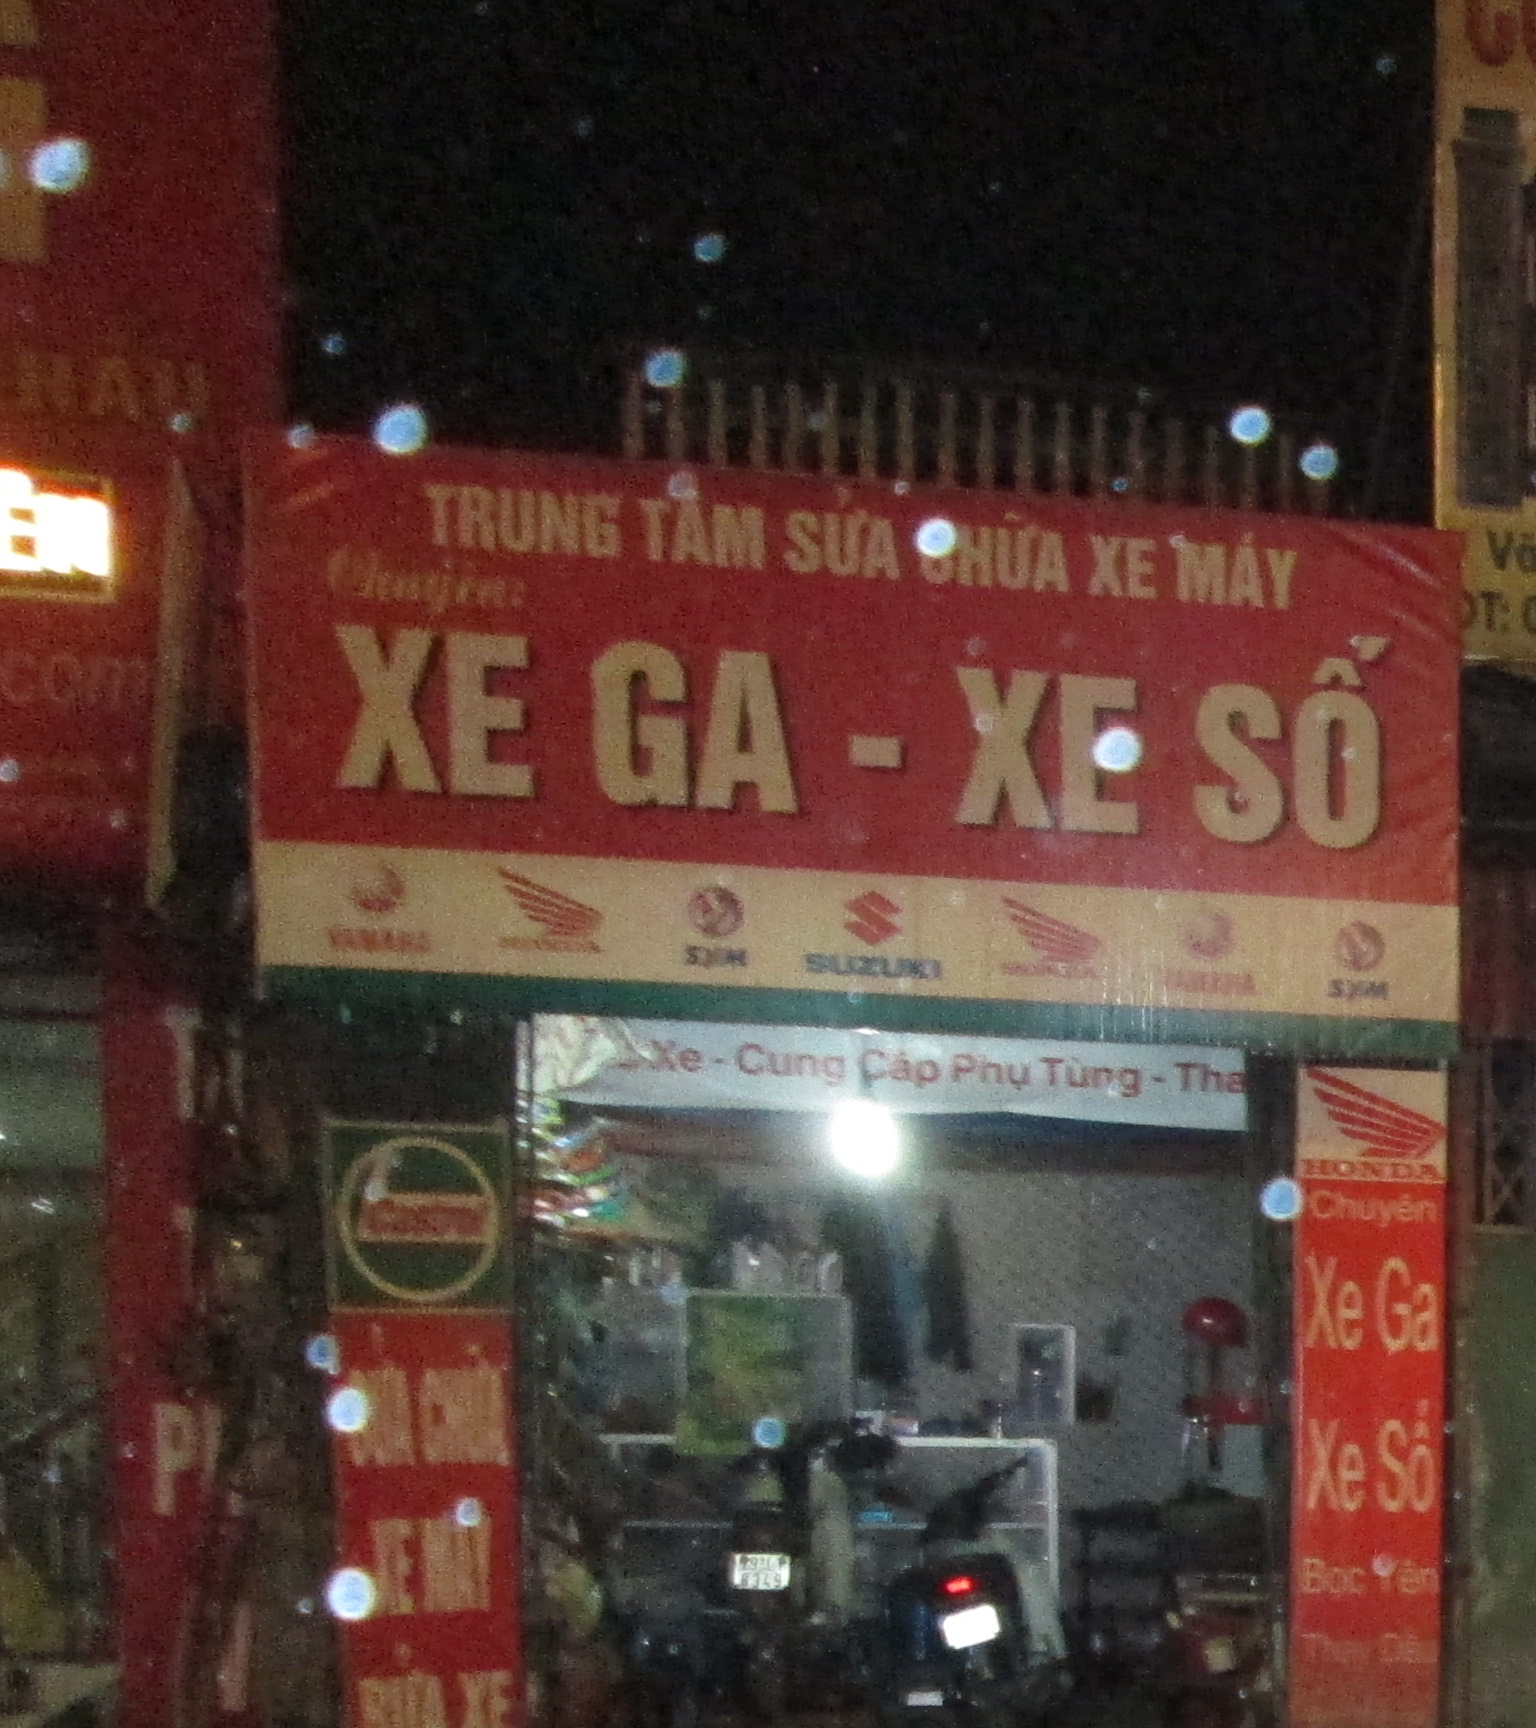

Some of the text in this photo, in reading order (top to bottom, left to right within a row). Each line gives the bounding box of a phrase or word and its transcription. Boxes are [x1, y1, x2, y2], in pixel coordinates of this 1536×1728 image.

[424, 482, 621, 560] TRUNG
[641, 494, 765, 571] TÂM
[782, 488, 901, 579] SỬA
[1089, 534, 1156, 600] XE
[1175, 530, 1298, 610] MÁY
[336, 624, 534, 798] XE
[590, 638, 799, 815] GA
[954, 666, 1141, 836] XE
[1194, 635, 1391, 851] SỐ
[736, 1042, 846, 1086] Cung
[949, 1051, 1031, 1094] Phụ
[1039, 1055, 1143, 1100] Tùng
[1303, 1256, 1440, 1354] Xe Ga
[1305, 1400, 1438, 1512] Xe Số
